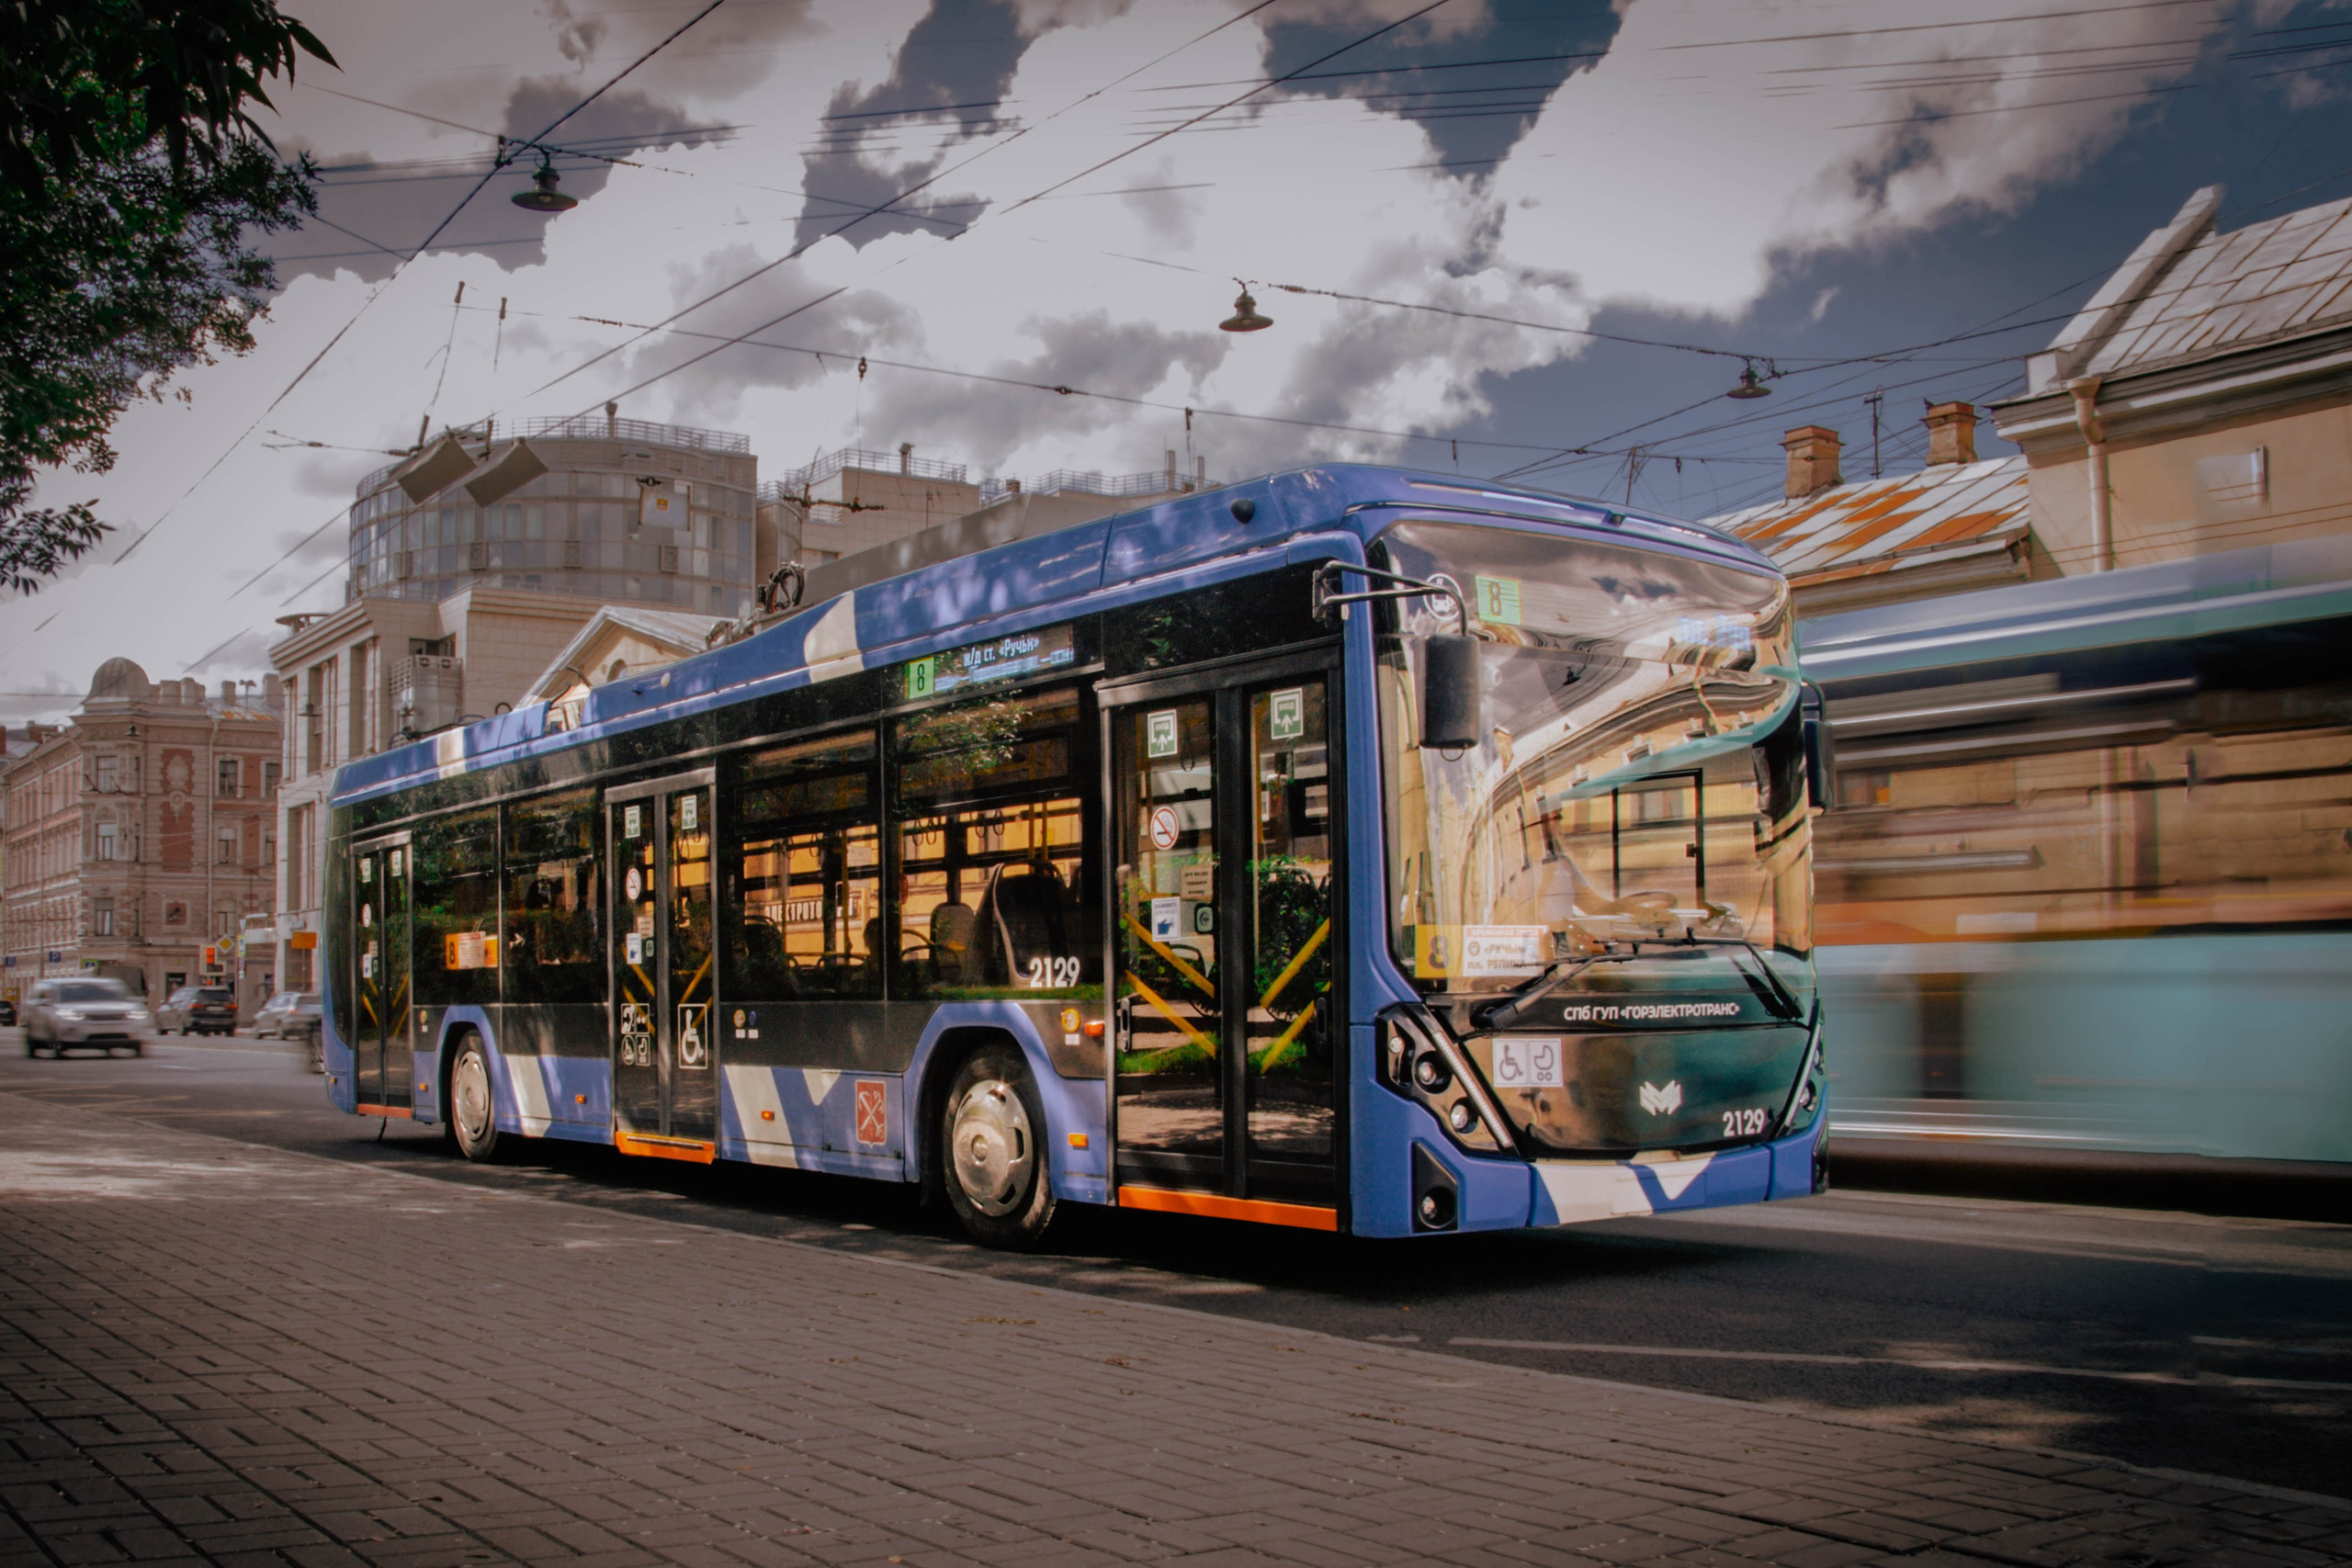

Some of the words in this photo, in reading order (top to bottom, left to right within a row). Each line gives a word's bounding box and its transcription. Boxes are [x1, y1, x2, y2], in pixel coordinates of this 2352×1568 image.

[1489, 581, 1501, 615] 8
[983, 647, 996, 662] ст.
[999, 637, 1040, 658] «Ручьи»
[917, 663, 925, 691] 8
[449, 942, 456, 964] 8
[1429, 935, 1449, 969] 8
[1030, 956, 1080, 987] 2129
[1564, 1006, 1591, 1021] СПб
[1592, 1006, 1619, 1021] ГУП
[1620, 1002, 1741, 1020] «ГОРЭЛЕКТРОТРАНС»
[1723, 1108, 1766, 1137] 2129
